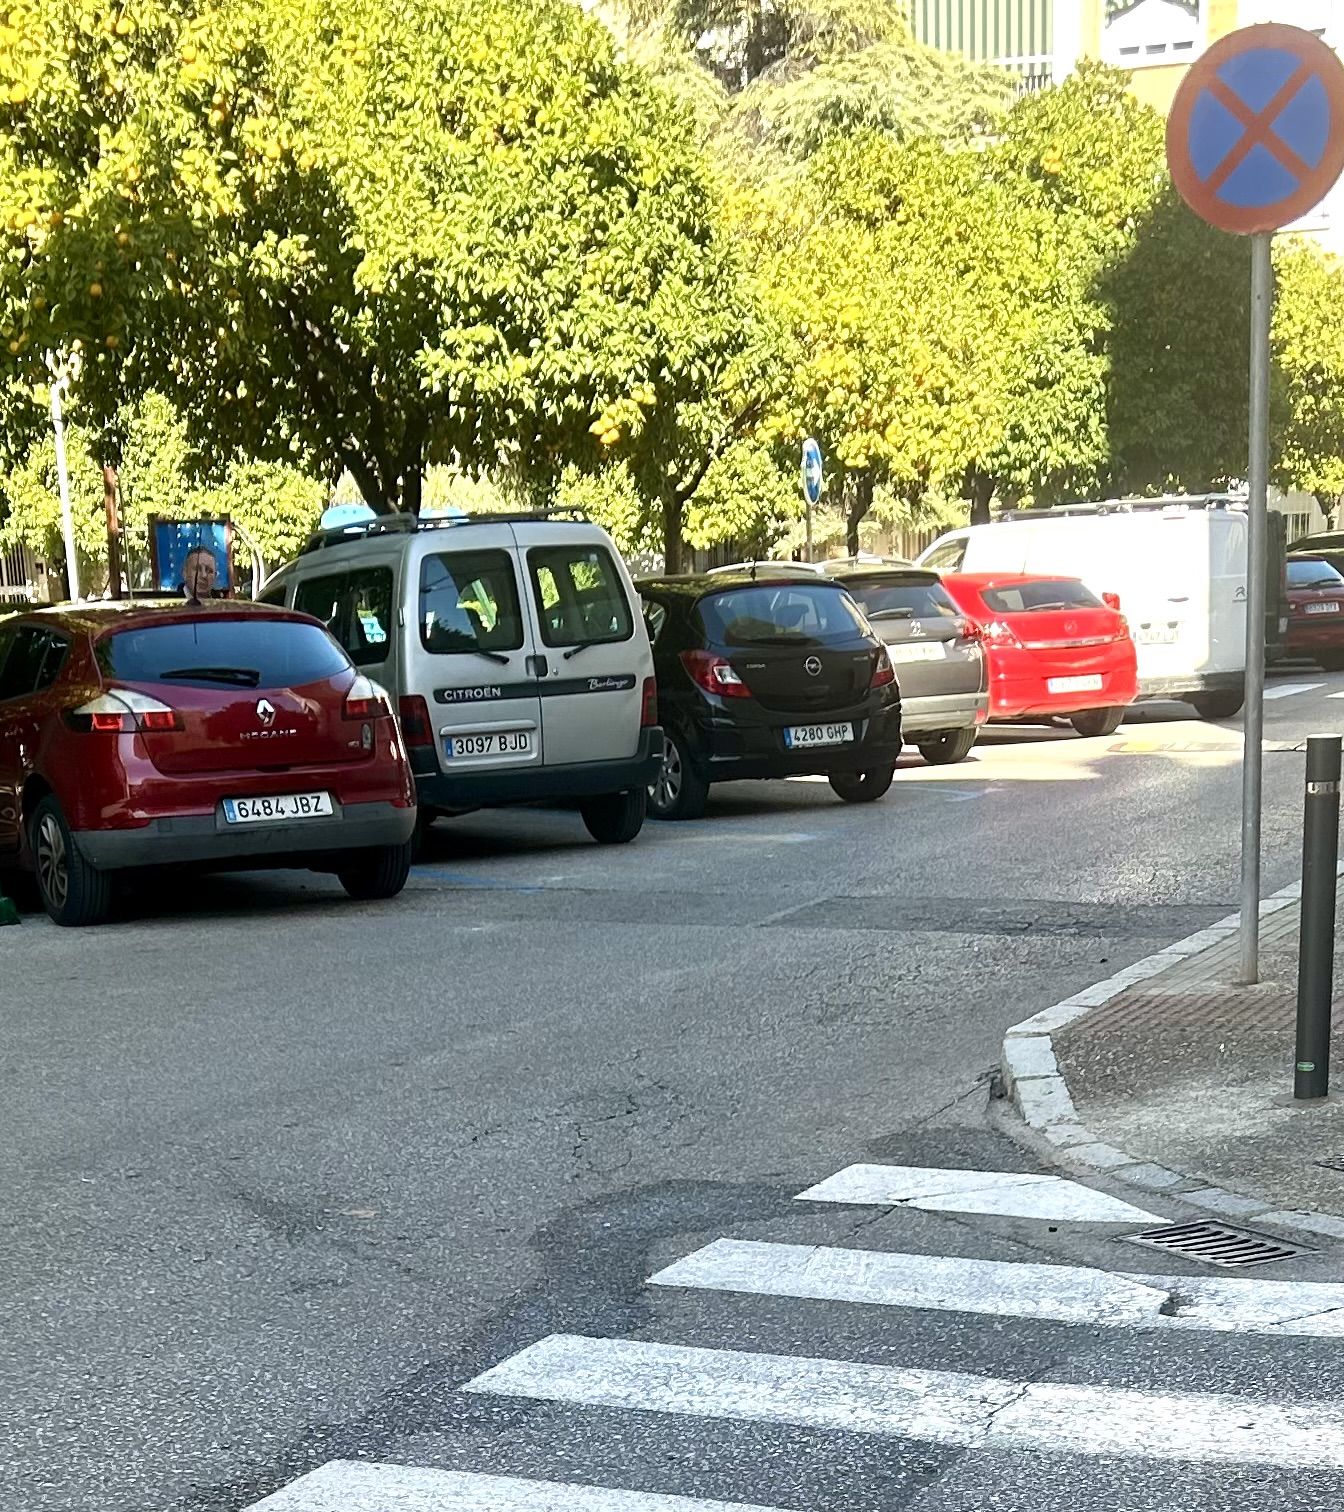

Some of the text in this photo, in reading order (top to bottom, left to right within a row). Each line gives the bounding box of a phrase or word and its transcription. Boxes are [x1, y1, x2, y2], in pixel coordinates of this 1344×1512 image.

[444, 678, 629, 700] CITROËN Berlingo
[793, 723, 848, 742] 4280 GHP
[455, 733, 528, 754] 3097 BJD
[237, 795, 323, 818] 6484 JBZ
